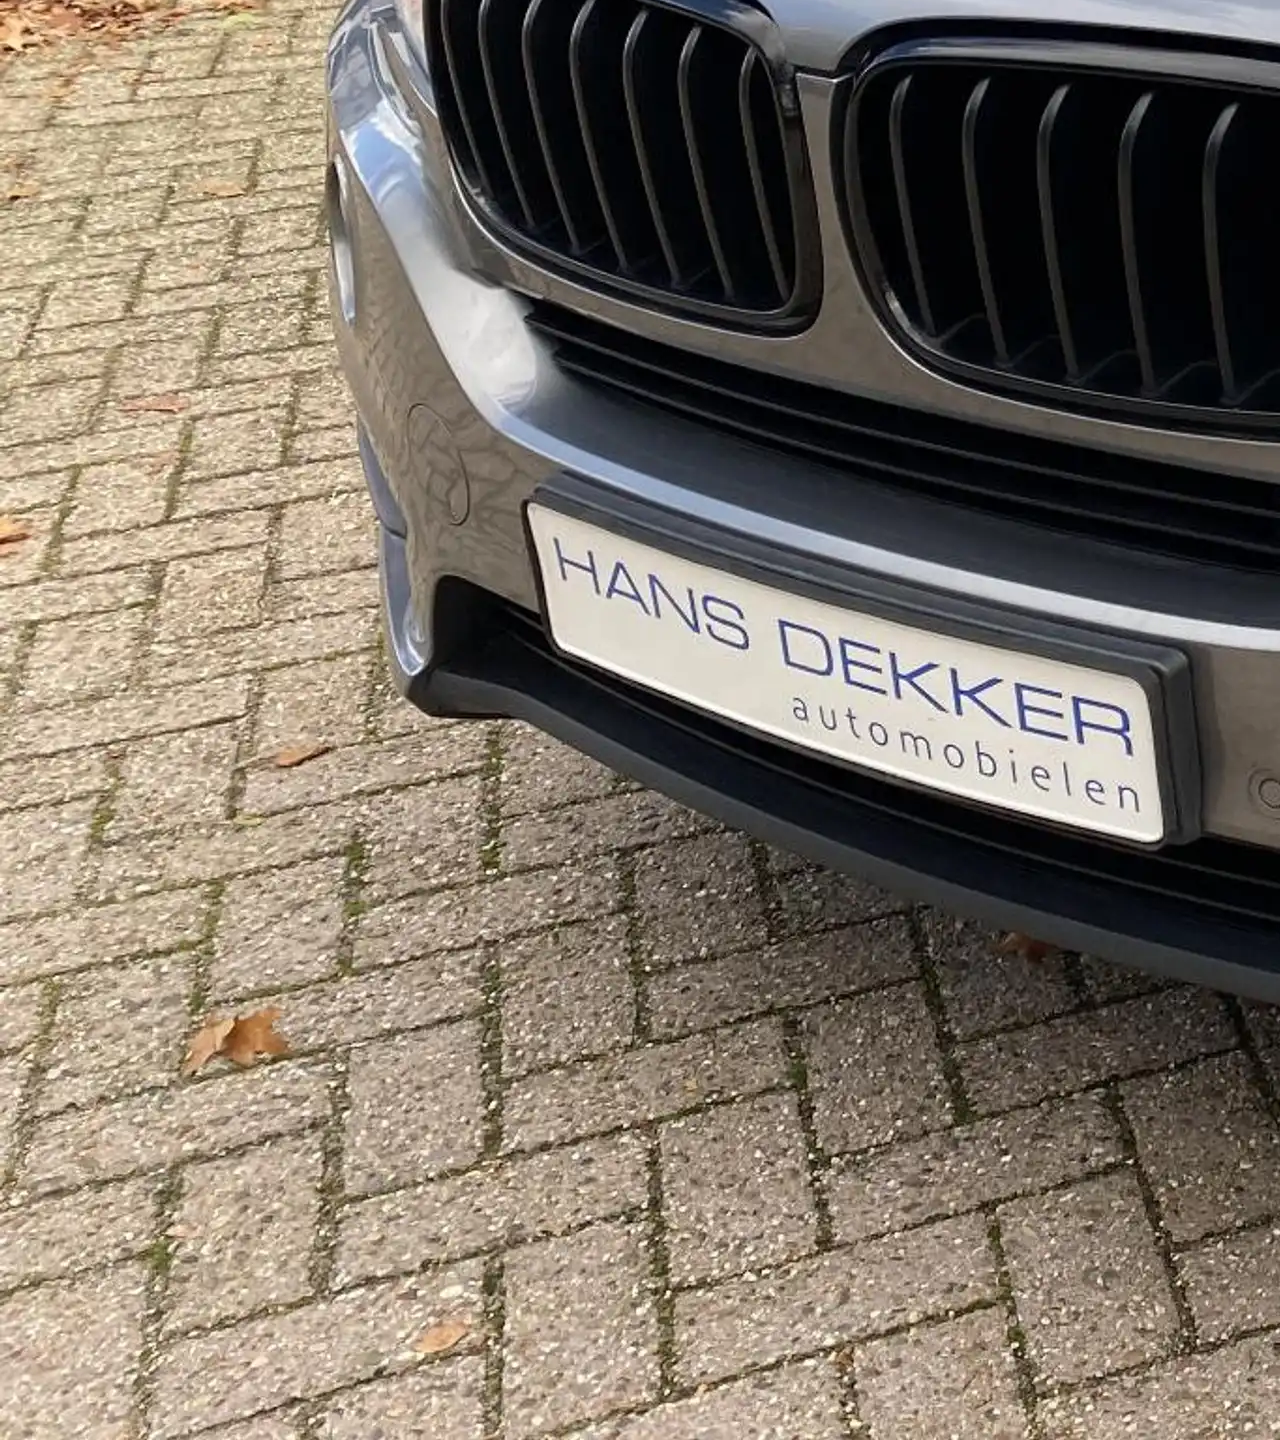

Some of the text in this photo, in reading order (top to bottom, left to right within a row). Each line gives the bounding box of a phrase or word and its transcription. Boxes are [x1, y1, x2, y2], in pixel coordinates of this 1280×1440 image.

[554, 536, 1133, 757] HANS DEKKER
[792, 693, 1141, 814] automobielen
